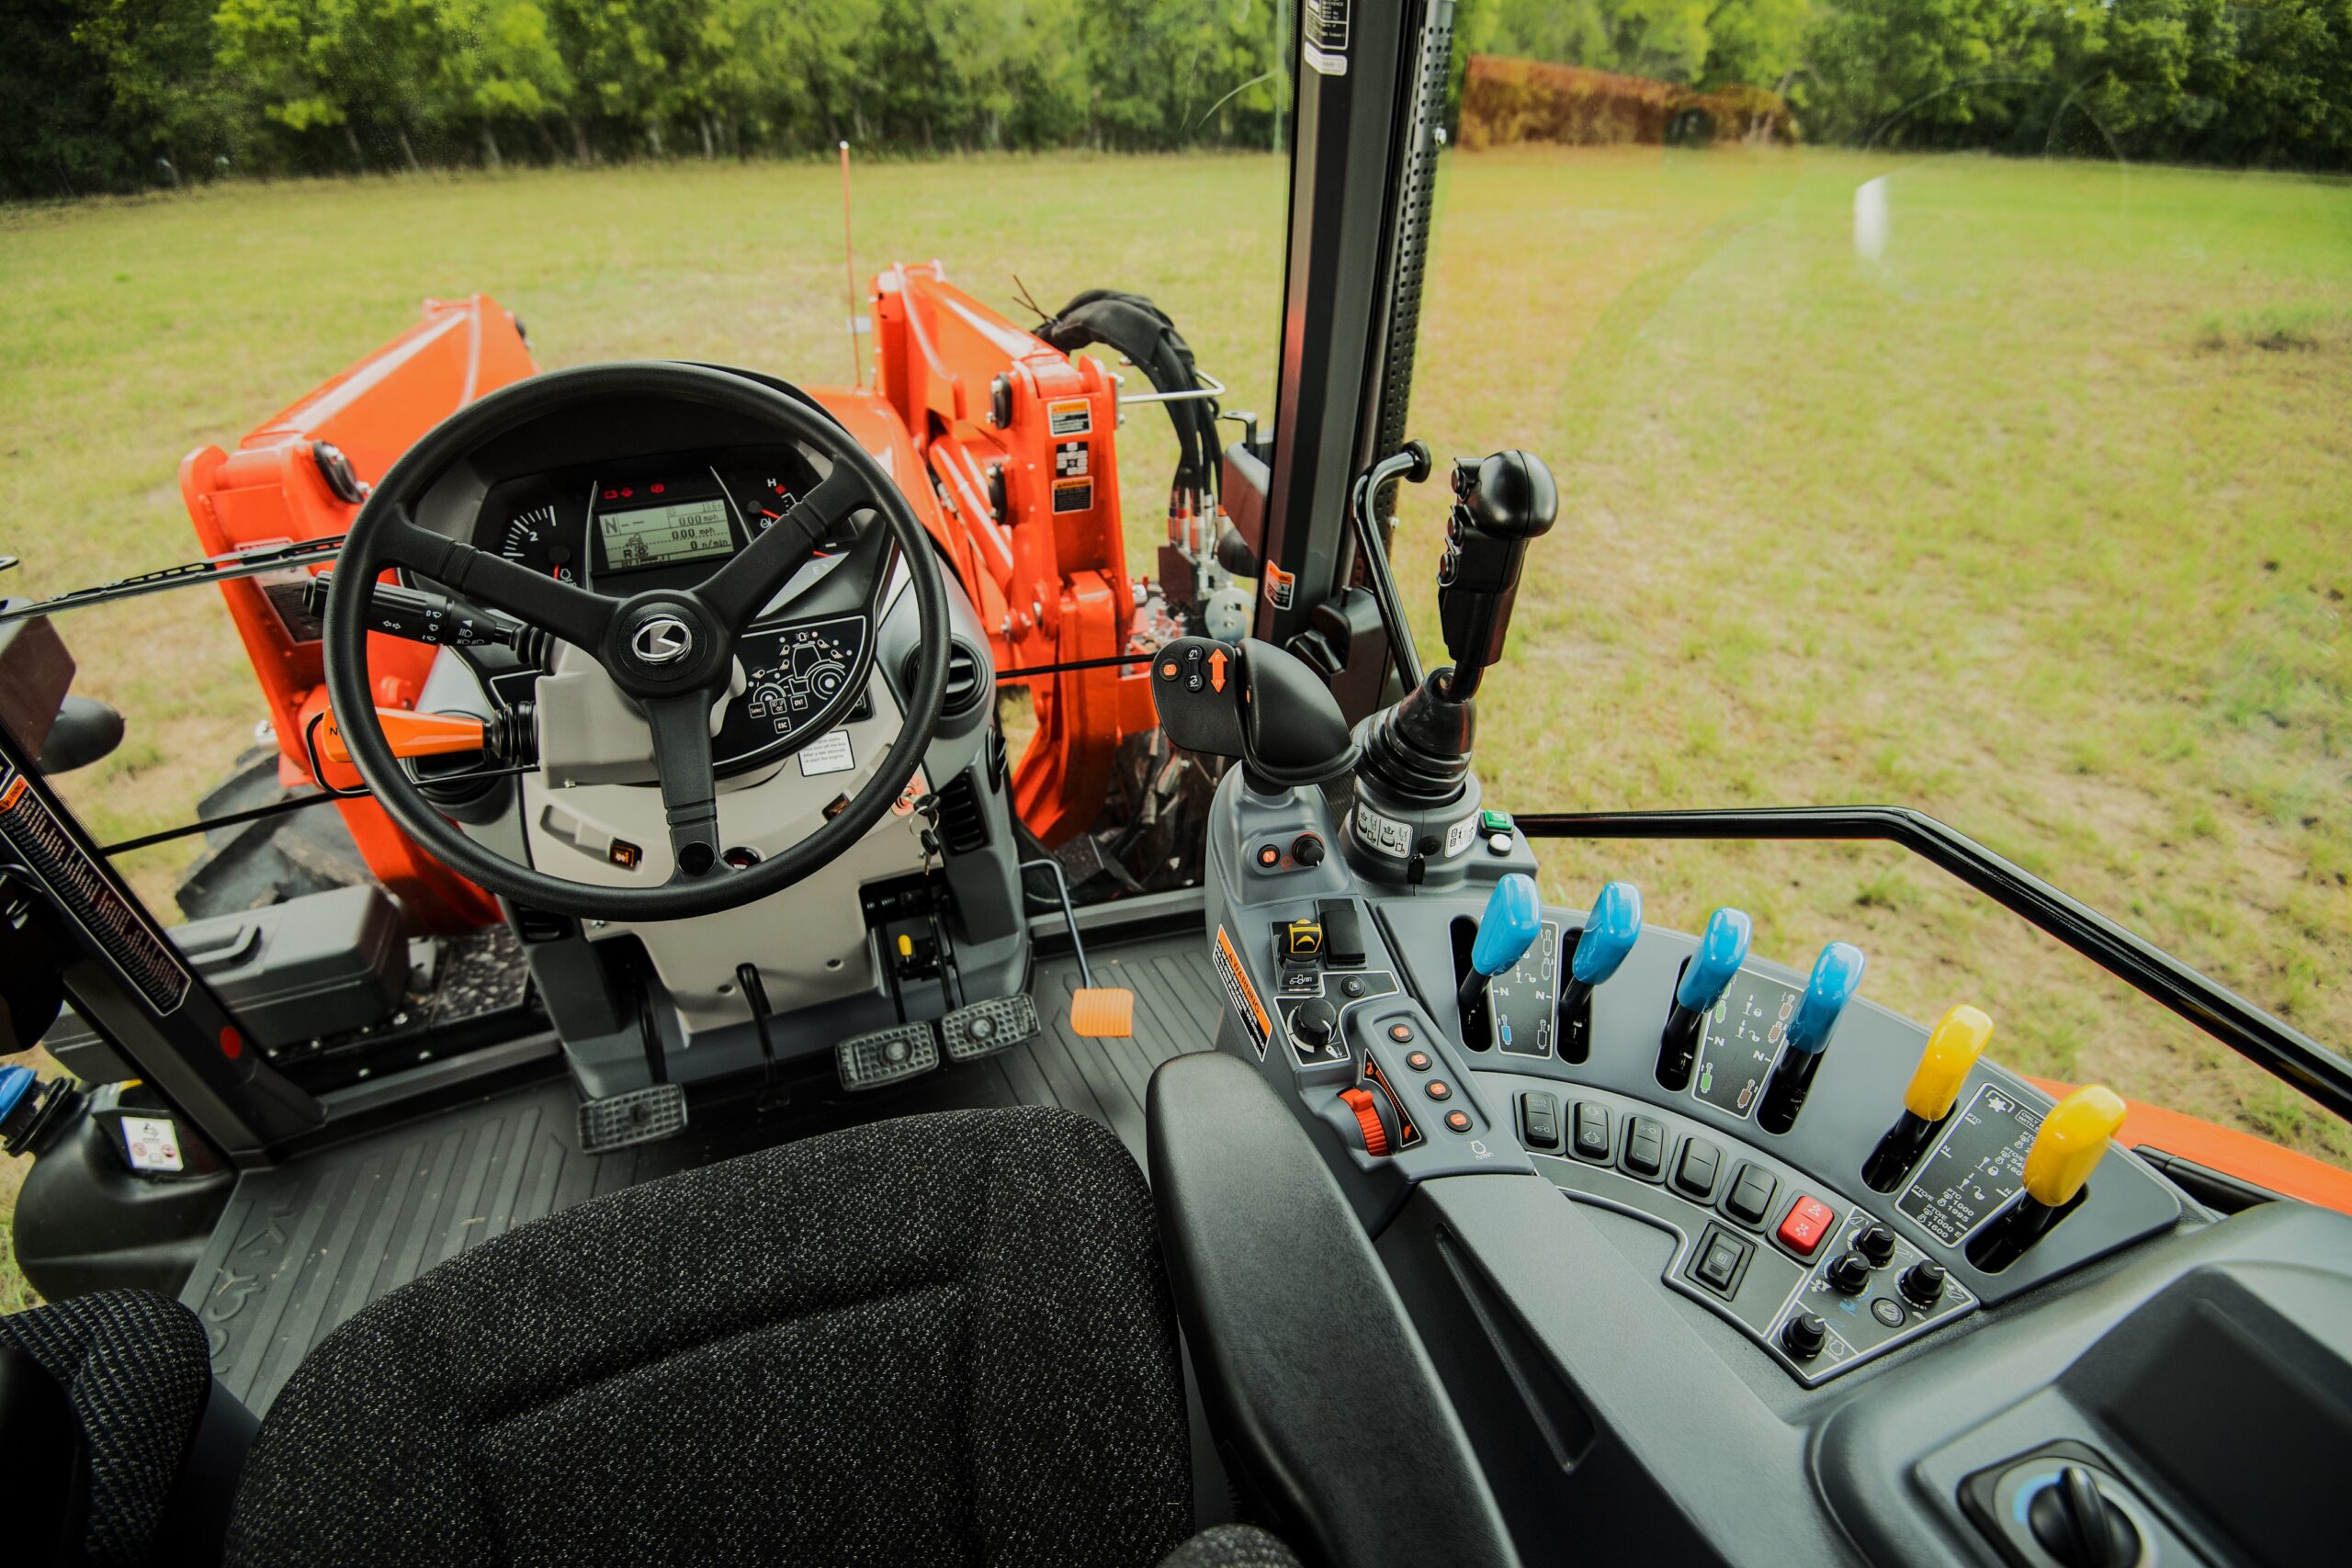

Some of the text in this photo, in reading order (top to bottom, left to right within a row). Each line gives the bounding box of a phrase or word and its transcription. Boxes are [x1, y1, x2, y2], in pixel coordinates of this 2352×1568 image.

[767, 479, 776, 488] H
[605, 517, 617, 534] N
[703, 514, 719, 524] mph
[529, 532, 539, 542] 2
[699, 528, 716, 536] mph
[691, 540, 729, 550] 0 n/min
[623, 549, 632, 558] R
[329, 728, 338, 736] N
[4, 781, 24, 806] WARNING
[1265, 852, 1273, 862] N
[1233, 962, 1260, 1013] WARNING
[1499, 987, 1510, 997] N
[1535, 991, 1545, 1000] N
[1397, 1029, 1406, 1037] A
[1713, 1036, 1725, 1046] N
[1415, 1056, 1423, 1065] B
[1753, 1051, 1765, 1061] N
[1967, 1112, 1982, 1124] PTO
[2017, 1114, 2035, 1128] WITH
[2020, 1111, 2040, 1125] ONLY
[1943, 1145, 1951, 1153] N
[2010, 1157, 2025, 1169] 54
[2006, 1164, 2022, 1177] 160
[1913, 1185, 1935, 1201] PTO/E
[1946, 1188, 1962, 1200] PTO
[1927, 1203, 1949, 1221] PTO/E
[1947, 1205, 1970, 1223] 1995
[1952, 1200, 1975, 1217] 1000
[1932, 1215, 1954, 1233] 1000
[1928, 1222, 1949, 1239] 1600
[1954, 1231, 1963, 1239] E
